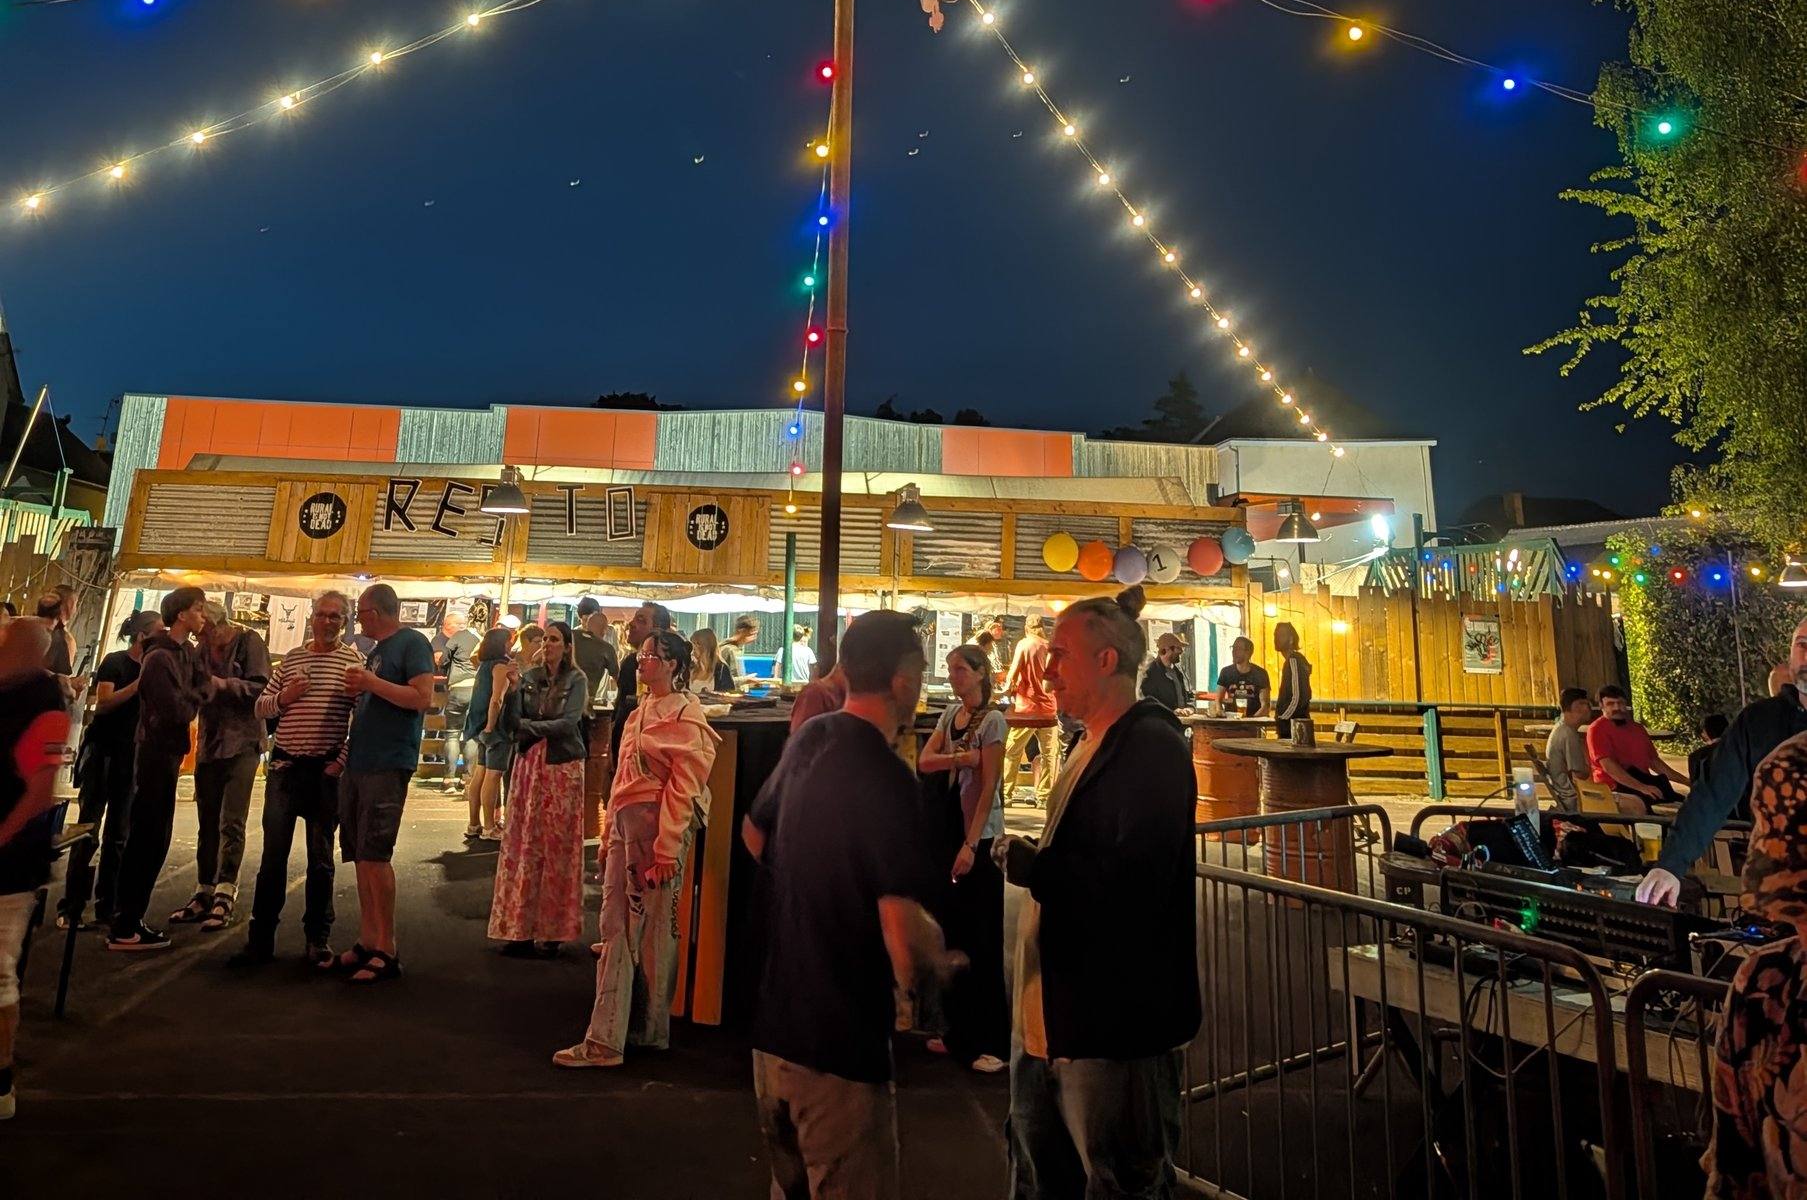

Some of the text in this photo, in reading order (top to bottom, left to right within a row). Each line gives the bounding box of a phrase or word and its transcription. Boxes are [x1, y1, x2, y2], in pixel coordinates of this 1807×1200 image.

[310, 502, 333, 514] RURAL
[310, 519, 332, 530] DEAD
[696, 513, 719, 525] RURAL
[697, 530, 718, 541] DEAD
[1152, 554, 1167, 571] 1
